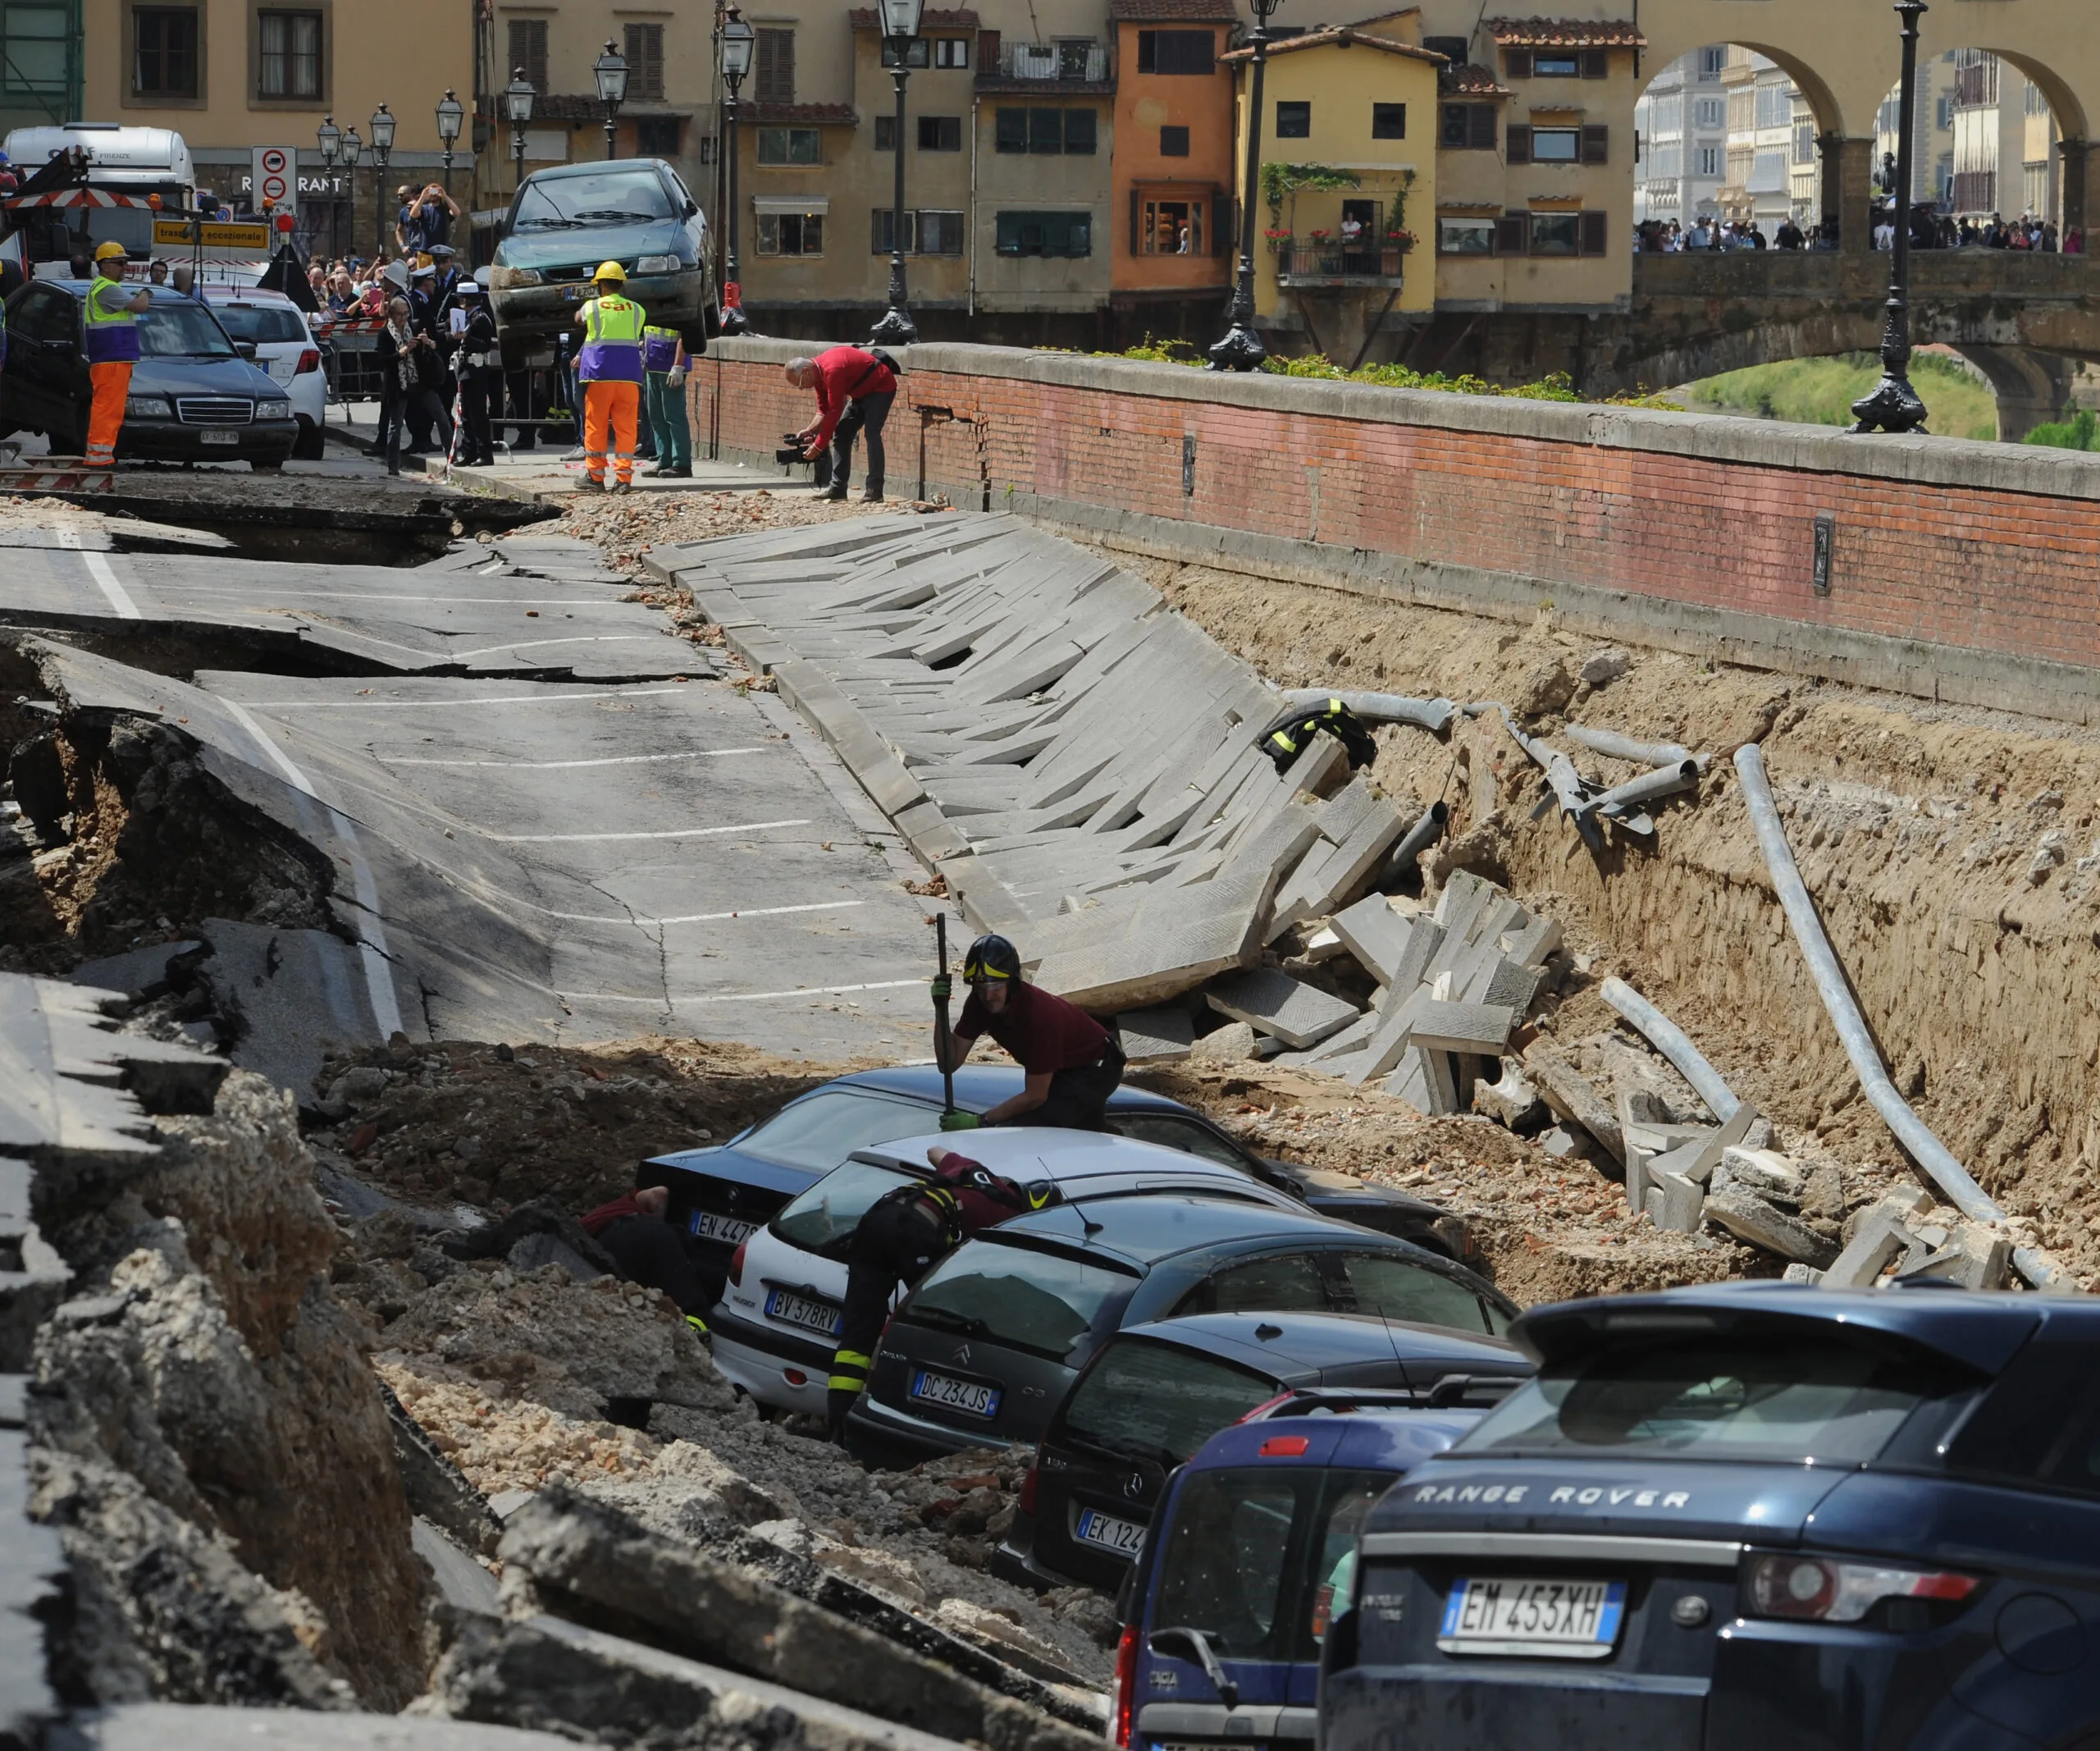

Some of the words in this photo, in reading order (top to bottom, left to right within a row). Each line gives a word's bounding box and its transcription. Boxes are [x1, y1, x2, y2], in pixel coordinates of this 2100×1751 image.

[207, 231, 262, 240] eccezionale
[698, 1214, 719, 1237] EN
[774, 1293, 793, 1316] BV
[795, 1300, 838, 1329] 378RV
[921, 1374, 941, 1397] DC
[943, 1380, 989, 1410] 234JS
[1414, 1486, 1529, 1503] RANGE
[1550, 1487, 1691, 1508] ROVER
[1088, 1515, 1111, 1542] EK
[1461, 1584, 1504, 1630] EM
[1506, 1584, 1604, 1634] 453XH
